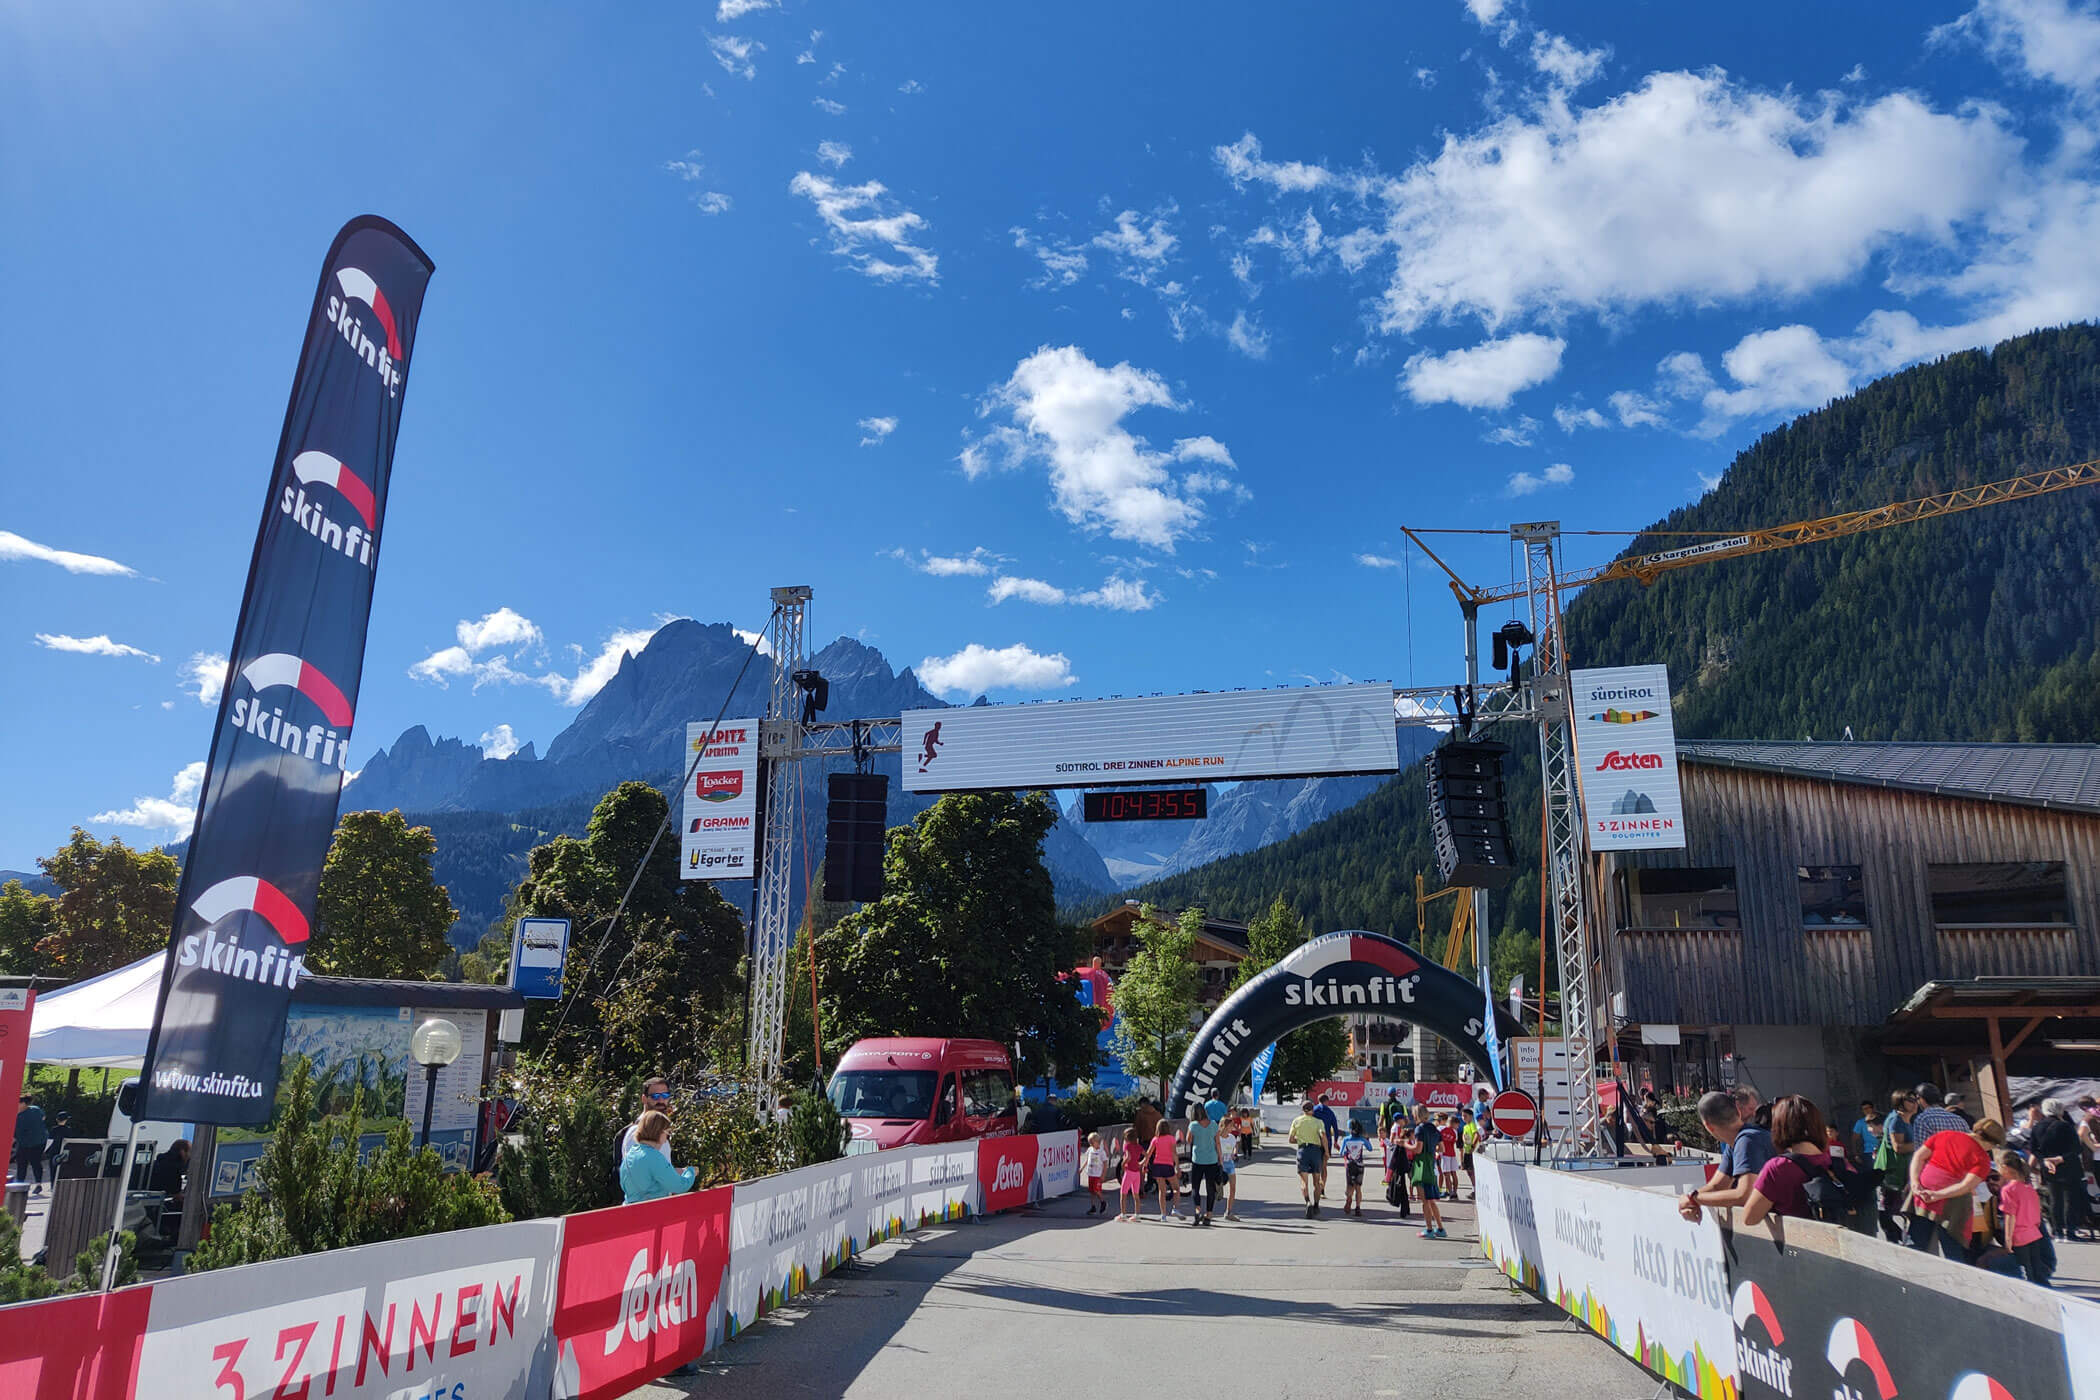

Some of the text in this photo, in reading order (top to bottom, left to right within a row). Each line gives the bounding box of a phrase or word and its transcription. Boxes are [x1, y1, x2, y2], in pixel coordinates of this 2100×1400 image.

[326, 295, 401, 399] skinfit
[280, 485, 374, 572] skinfi
[231, 697, 348, 772] skinfit
[698, 728, 747, 746] ALPITZ
[703, 746, 740, 758] APERITIVO
[1595, 750, 1663, 771] Sexten
[1055, 756, 1225, 773] SÜDTIROL DREI ZINNEN ALPINE RUN
[700, 775, 740, 789] Loacker
[1101, 792, 1198, 819] 10:43:55
[702, 815, 750, 829] GRAMM
[700, 853, 745, 868] Egarter
[179, 930, 303, 991] skinfit
[603, 1247, 698, 1357] Sexten
[273, 1274, 522, 1400] ZINNEN
